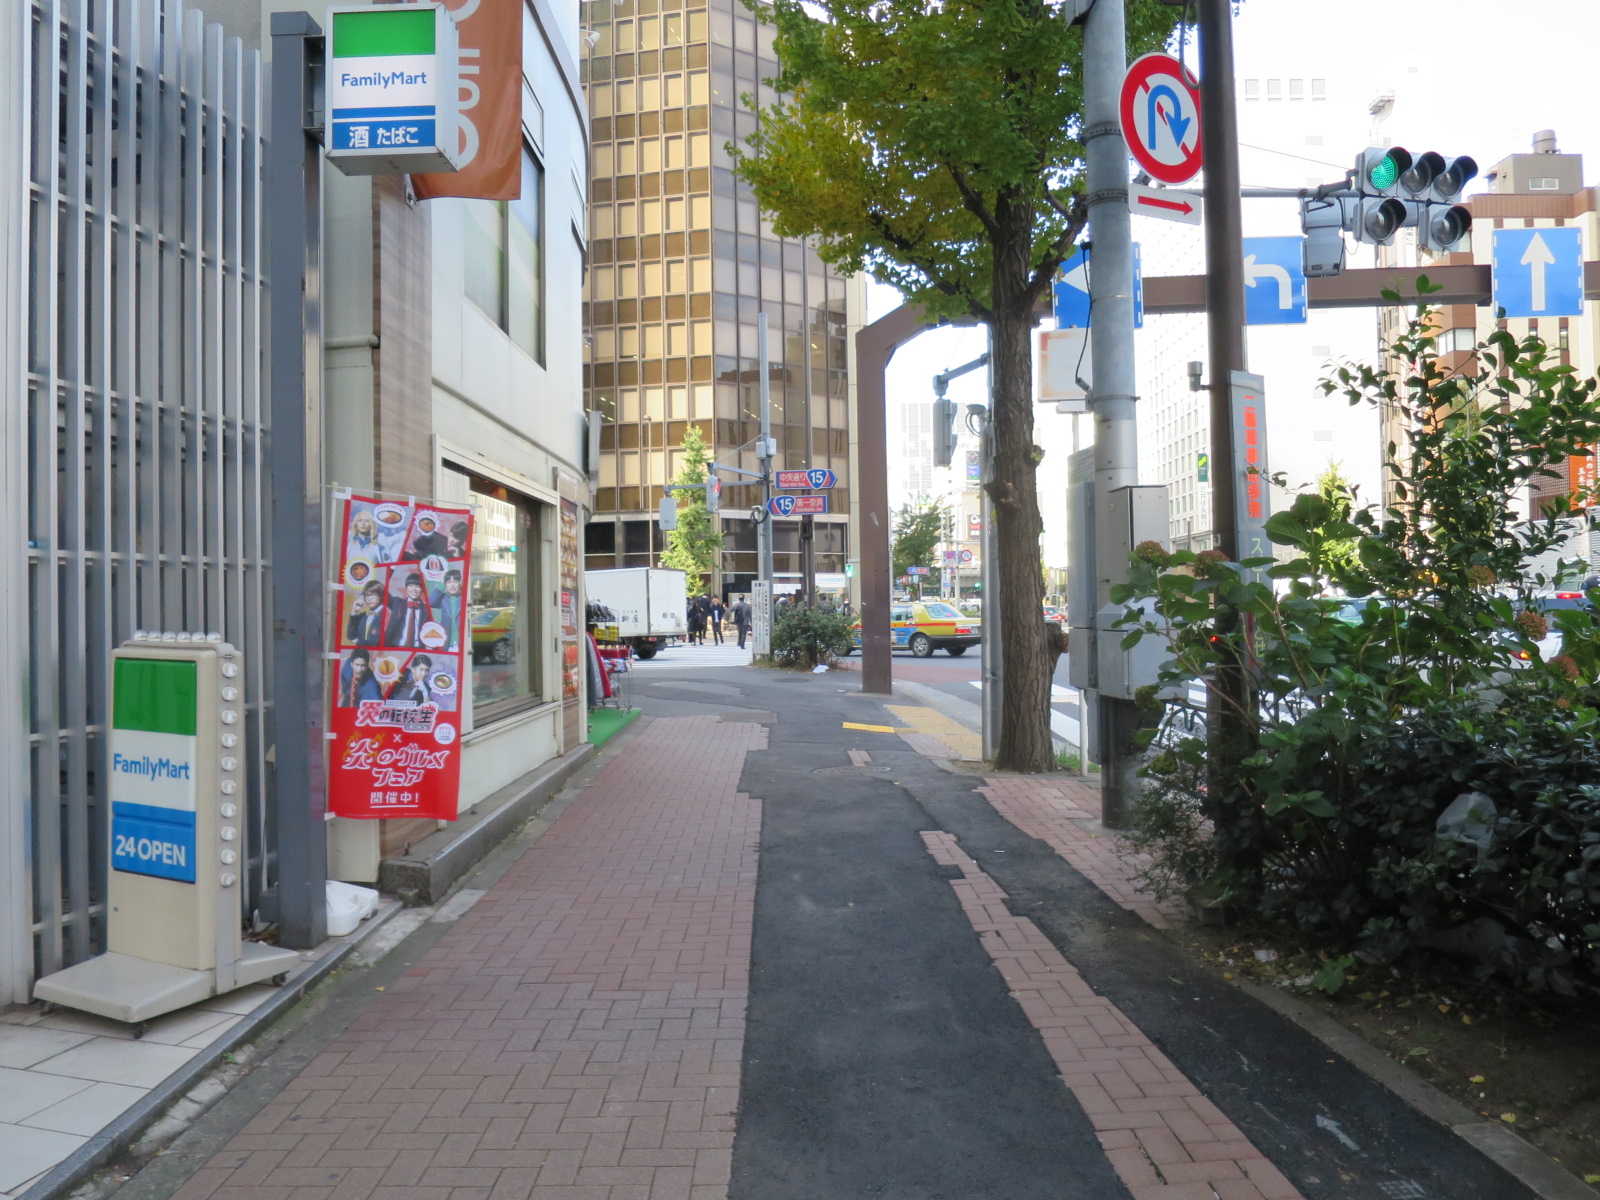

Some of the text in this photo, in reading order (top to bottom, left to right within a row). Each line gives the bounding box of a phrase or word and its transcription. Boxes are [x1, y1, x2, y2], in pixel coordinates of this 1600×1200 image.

[341, 71, 427, 89] FamilyMart
[349, 125, 419, 148] 酒 たばこ
[779, 471, 824, 484] 中央通り 15
[779, 498, 793, 511] 15
[357, 701, 435, 724] 炎の転校生
[342, 738, 450, 769] 炎のグルメ
[113, 753, 190, 781] FamilyMart
[372, 767, 424, 787] フェア
[370, 791, 419, 804] 開催中!
